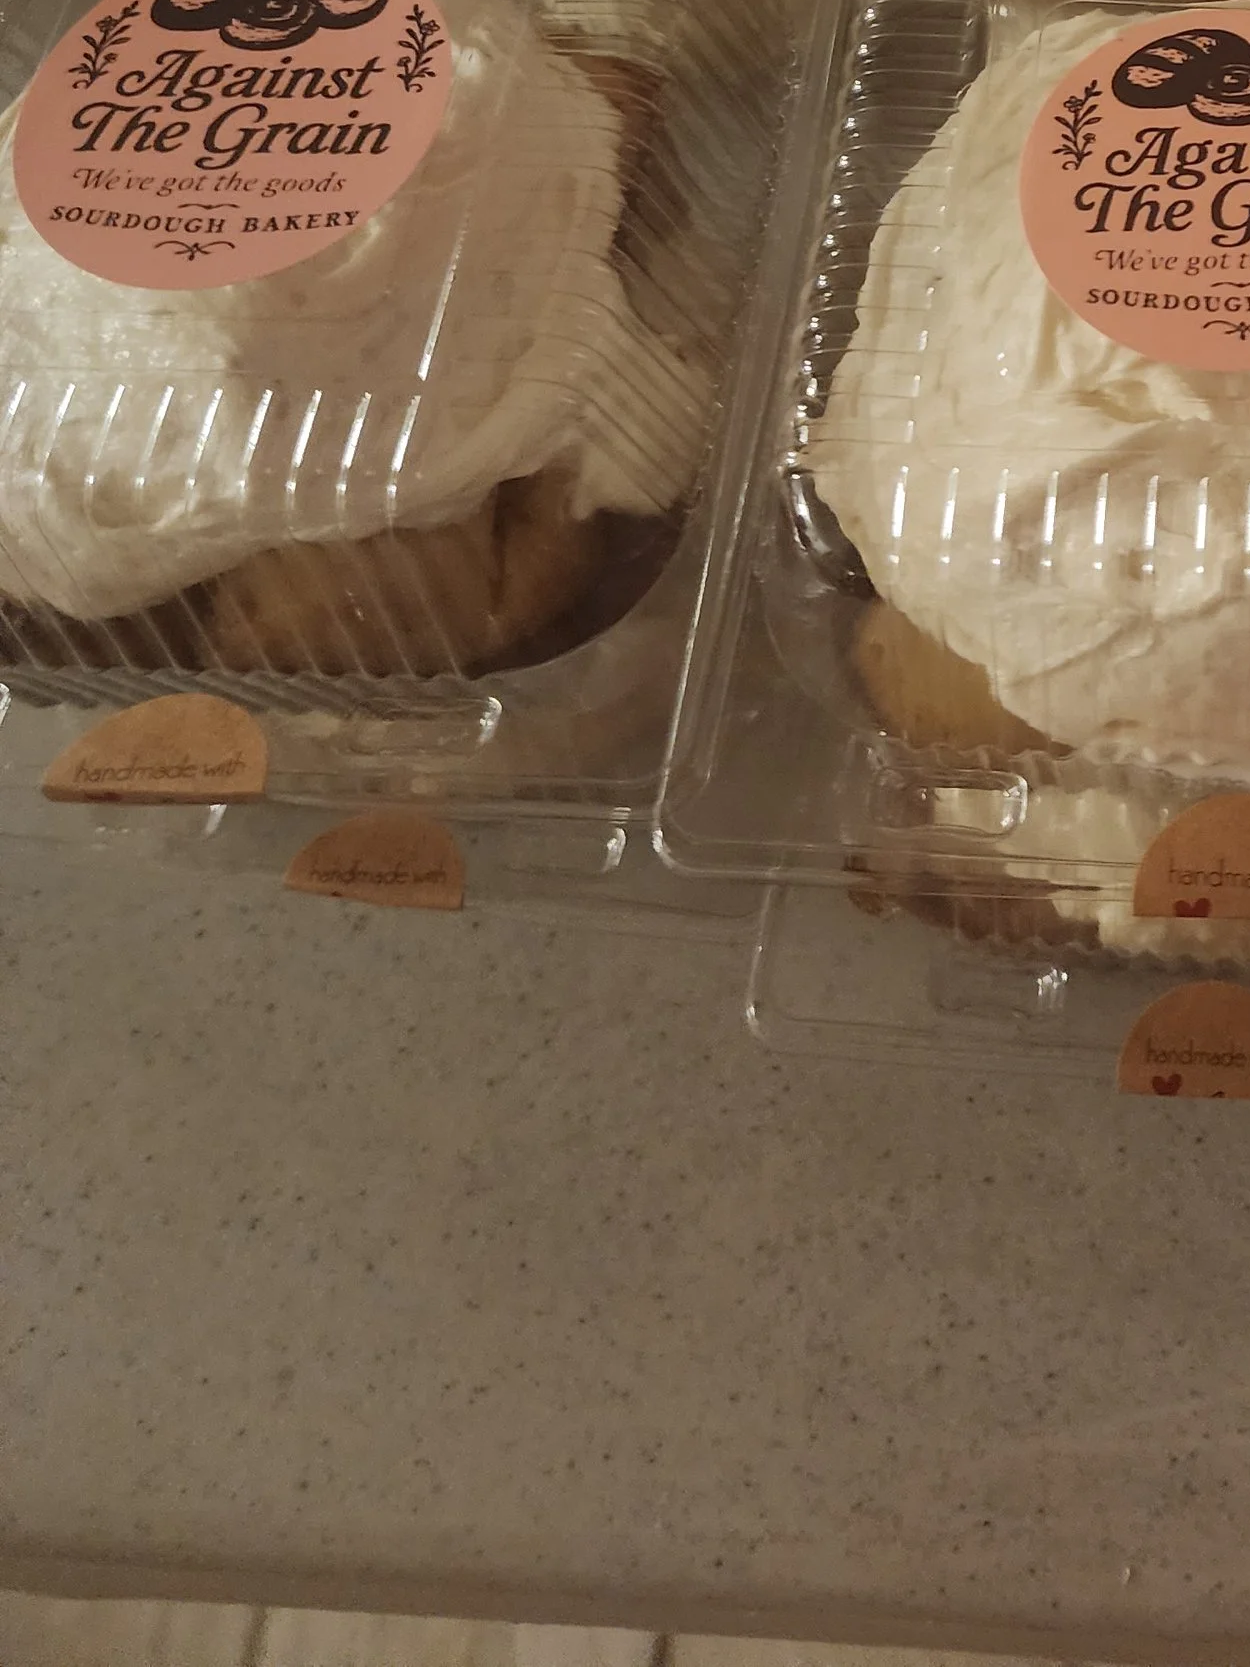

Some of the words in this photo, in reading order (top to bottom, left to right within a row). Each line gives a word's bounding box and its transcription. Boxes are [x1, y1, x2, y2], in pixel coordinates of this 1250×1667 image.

[115, 49, 385, 112] Against
[72, 101, 190, 153] The
[194, 103, 391, 170] Grain
[73, 168, 153, 192] We've
[156, 174, 207, 196] got
[213, 172, 258, 193] the
[260, 172, 347, 197] goods
[49, 205, 226, 234] SOURDOUGH
[242, 210, 361, 234] BAKERY
[1075, 182, 1194, 234] The
[1094, 248, 1178, 272] We've
[1184, 252, 1229, 275] got
[75, 754, 197, 784] handmade
[308, 859, 410, 885] handmade
[1144, 1037, 1247, 1067] handmade
